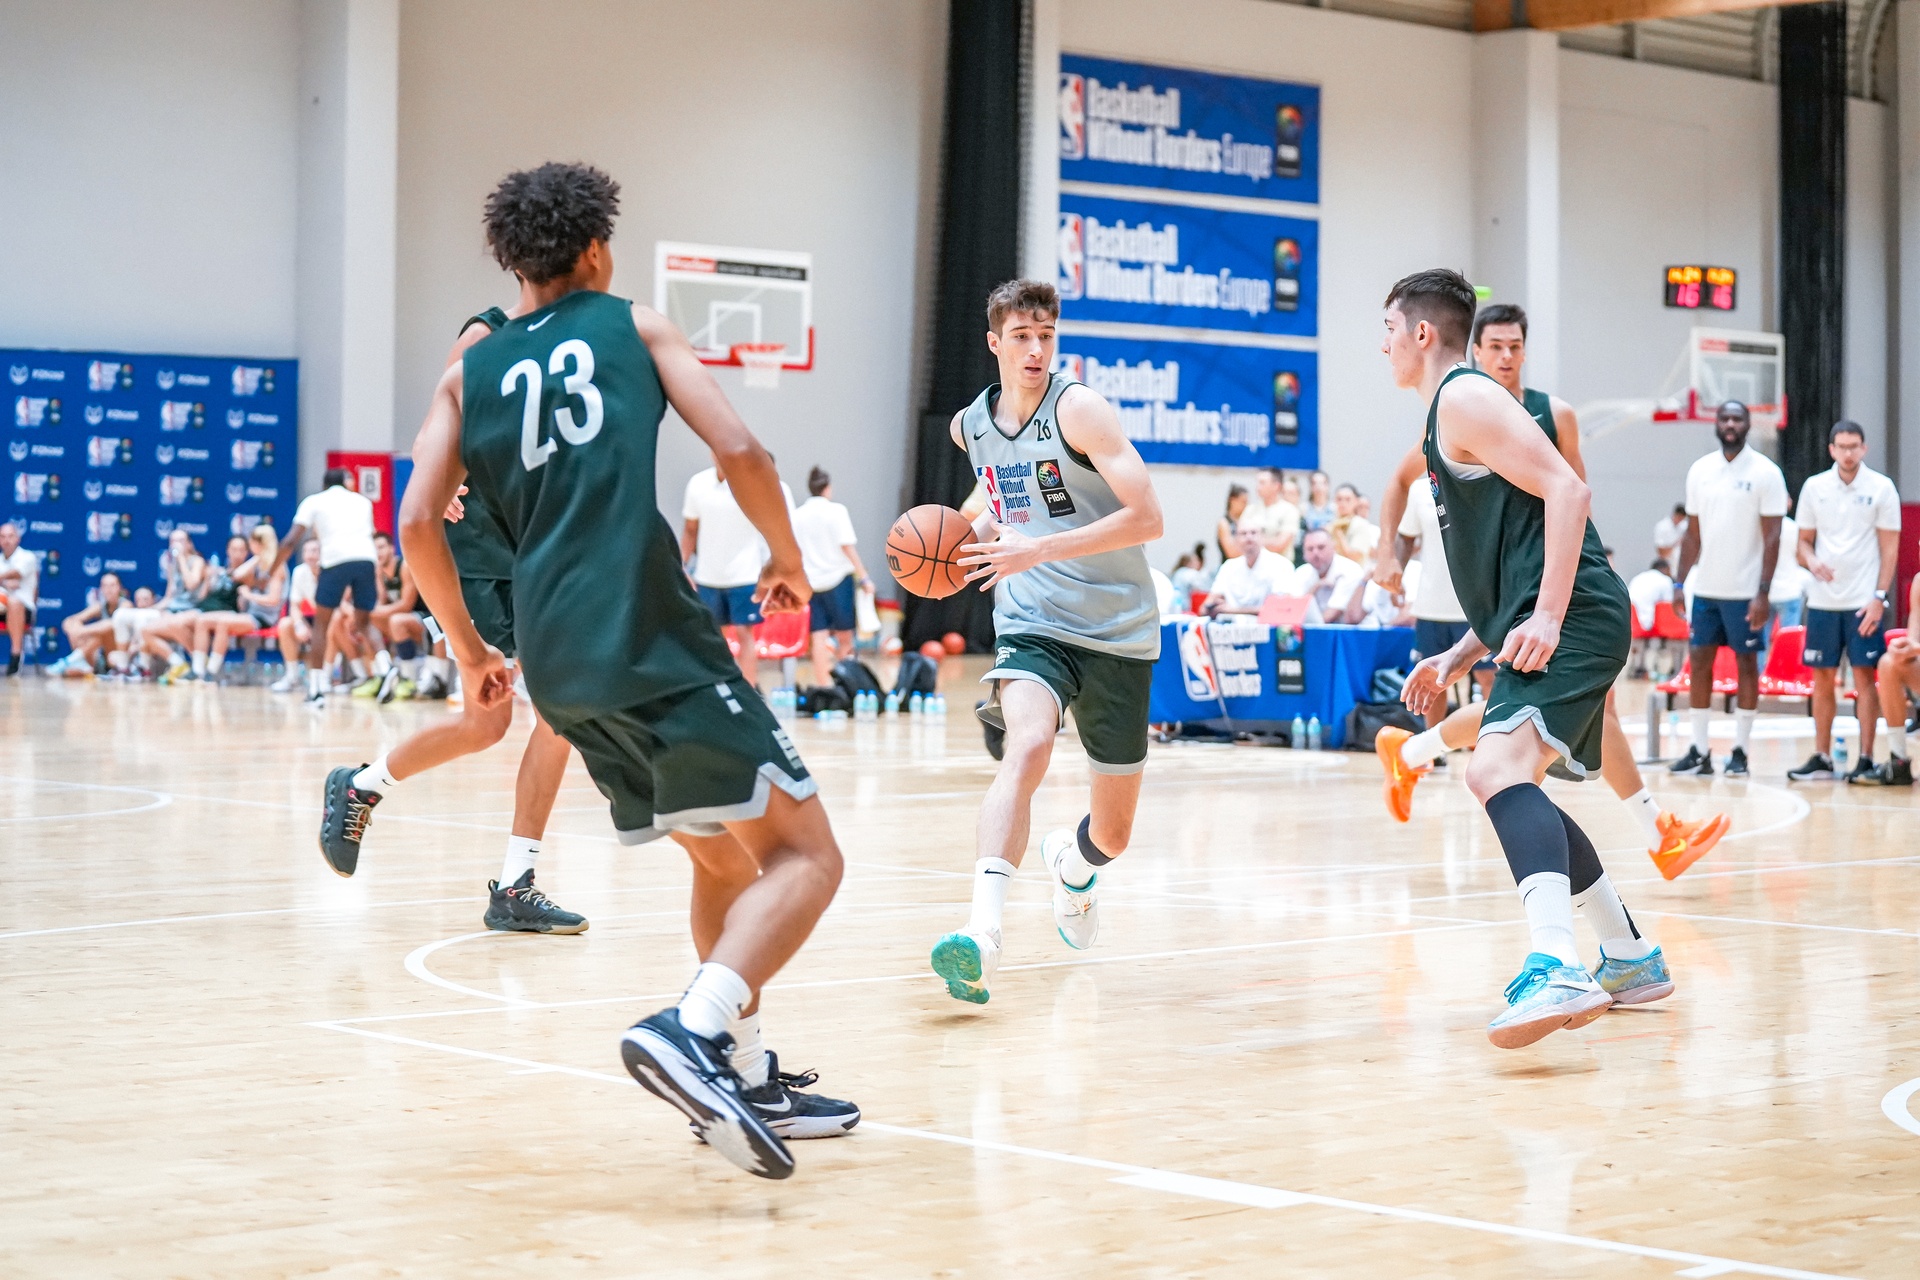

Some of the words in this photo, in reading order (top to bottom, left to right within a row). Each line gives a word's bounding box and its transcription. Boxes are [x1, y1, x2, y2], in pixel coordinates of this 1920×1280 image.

[1087, 77, 1180, 129] Basketball
[1087, 118, 1152, 165] Without
[1155, 126, 1221, 173] Borders
[1221, 133, 1272, 183] Europe
[1085, 216, 1178, 266] Basketball
[1085, 257, 1151, 303] Without
[1153, 263, 1218, 309] Borders
[1219, 267, 1270, 318] Europe
[1085, 356, 1179, 403] Basketball
[501, 338, 604, 472] 23
[1154, 400, 1220, 445] Borders
[1220, 403, 1269, 452] Europe
[1033, 418, 1052, 441] 26
[995, 461, 1032, 480] Basketball
[998, 479, 1026, 495] Without
[1003, 495, 1031, 509] Borders
[1006, 510, 1030, 525] Europe
[1046, 491, 1067, 504] FIBA
